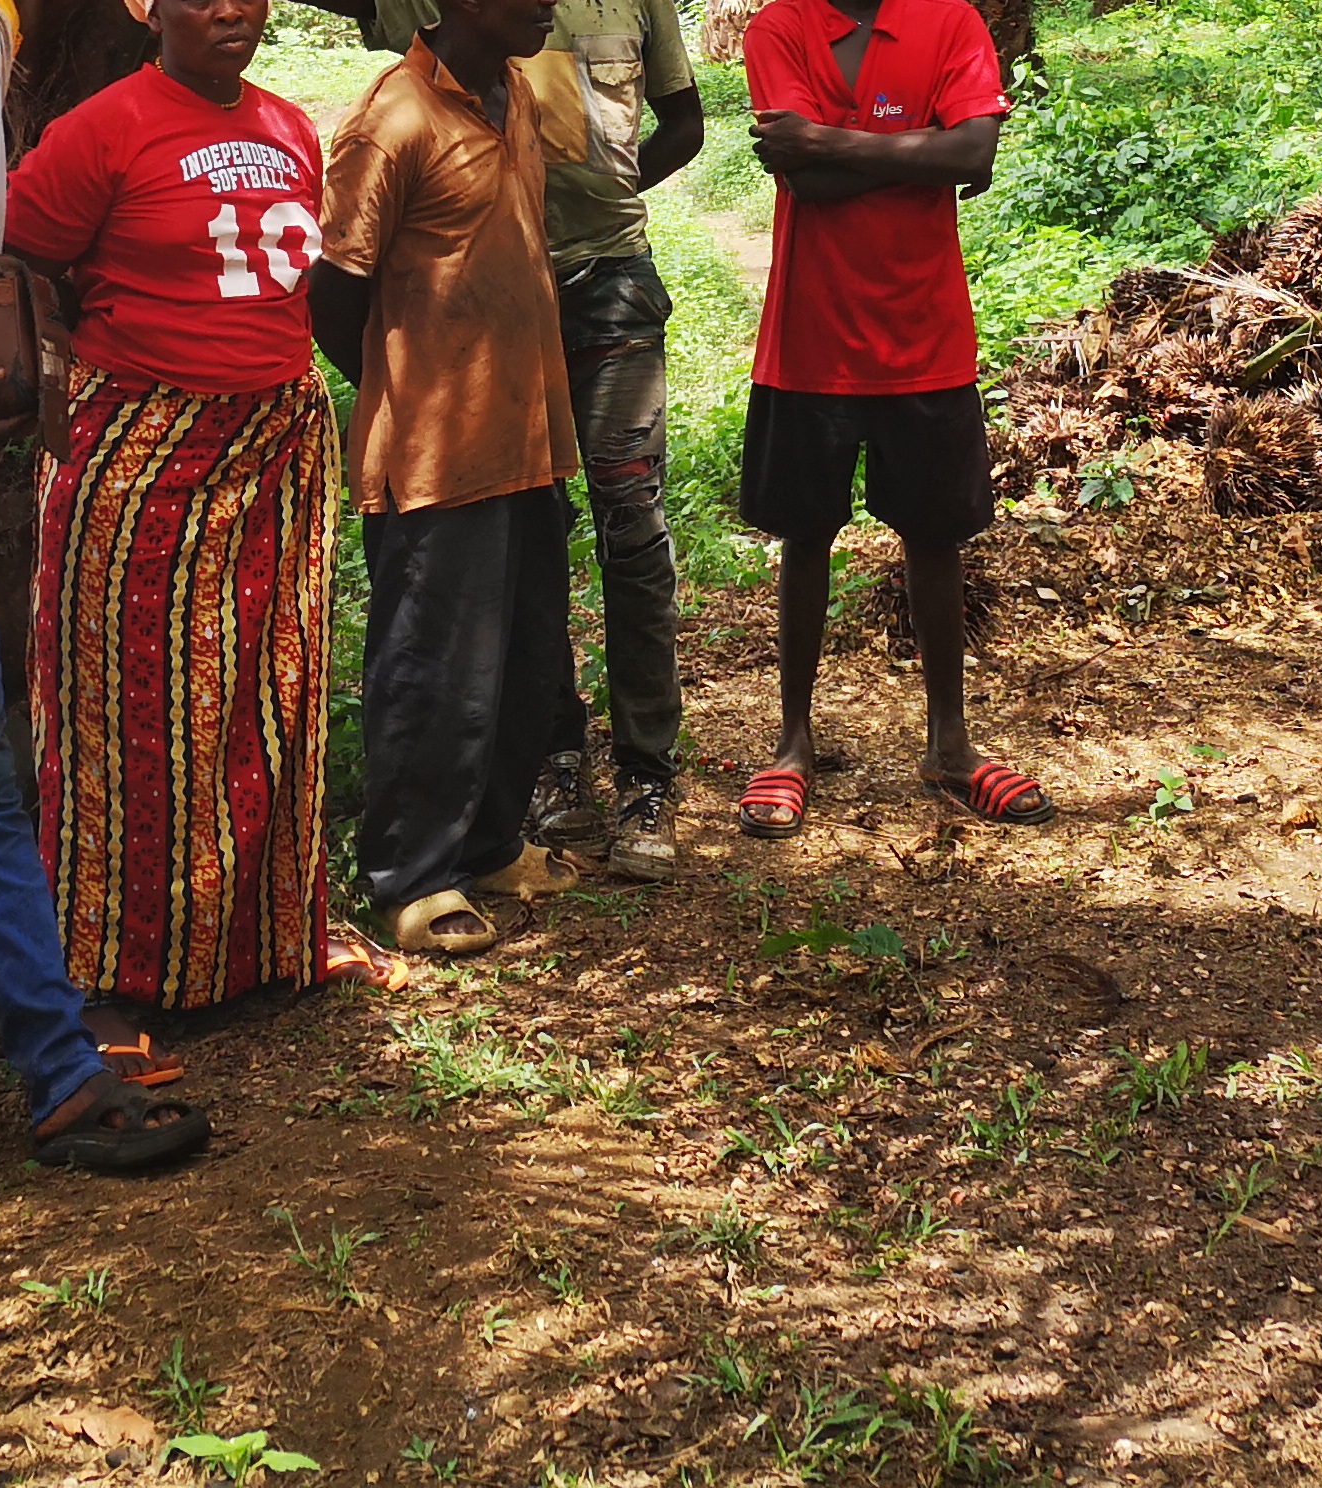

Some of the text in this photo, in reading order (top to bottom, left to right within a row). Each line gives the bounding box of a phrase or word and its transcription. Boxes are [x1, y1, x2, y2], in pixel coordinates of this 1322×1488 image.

[873, 103, 903, 118] Lyles
[180, 141, 299, 182] INDEPENDENCE
[209, 166, 291, 194] SOFTBALL
[208, 202, 323, 298] 10
